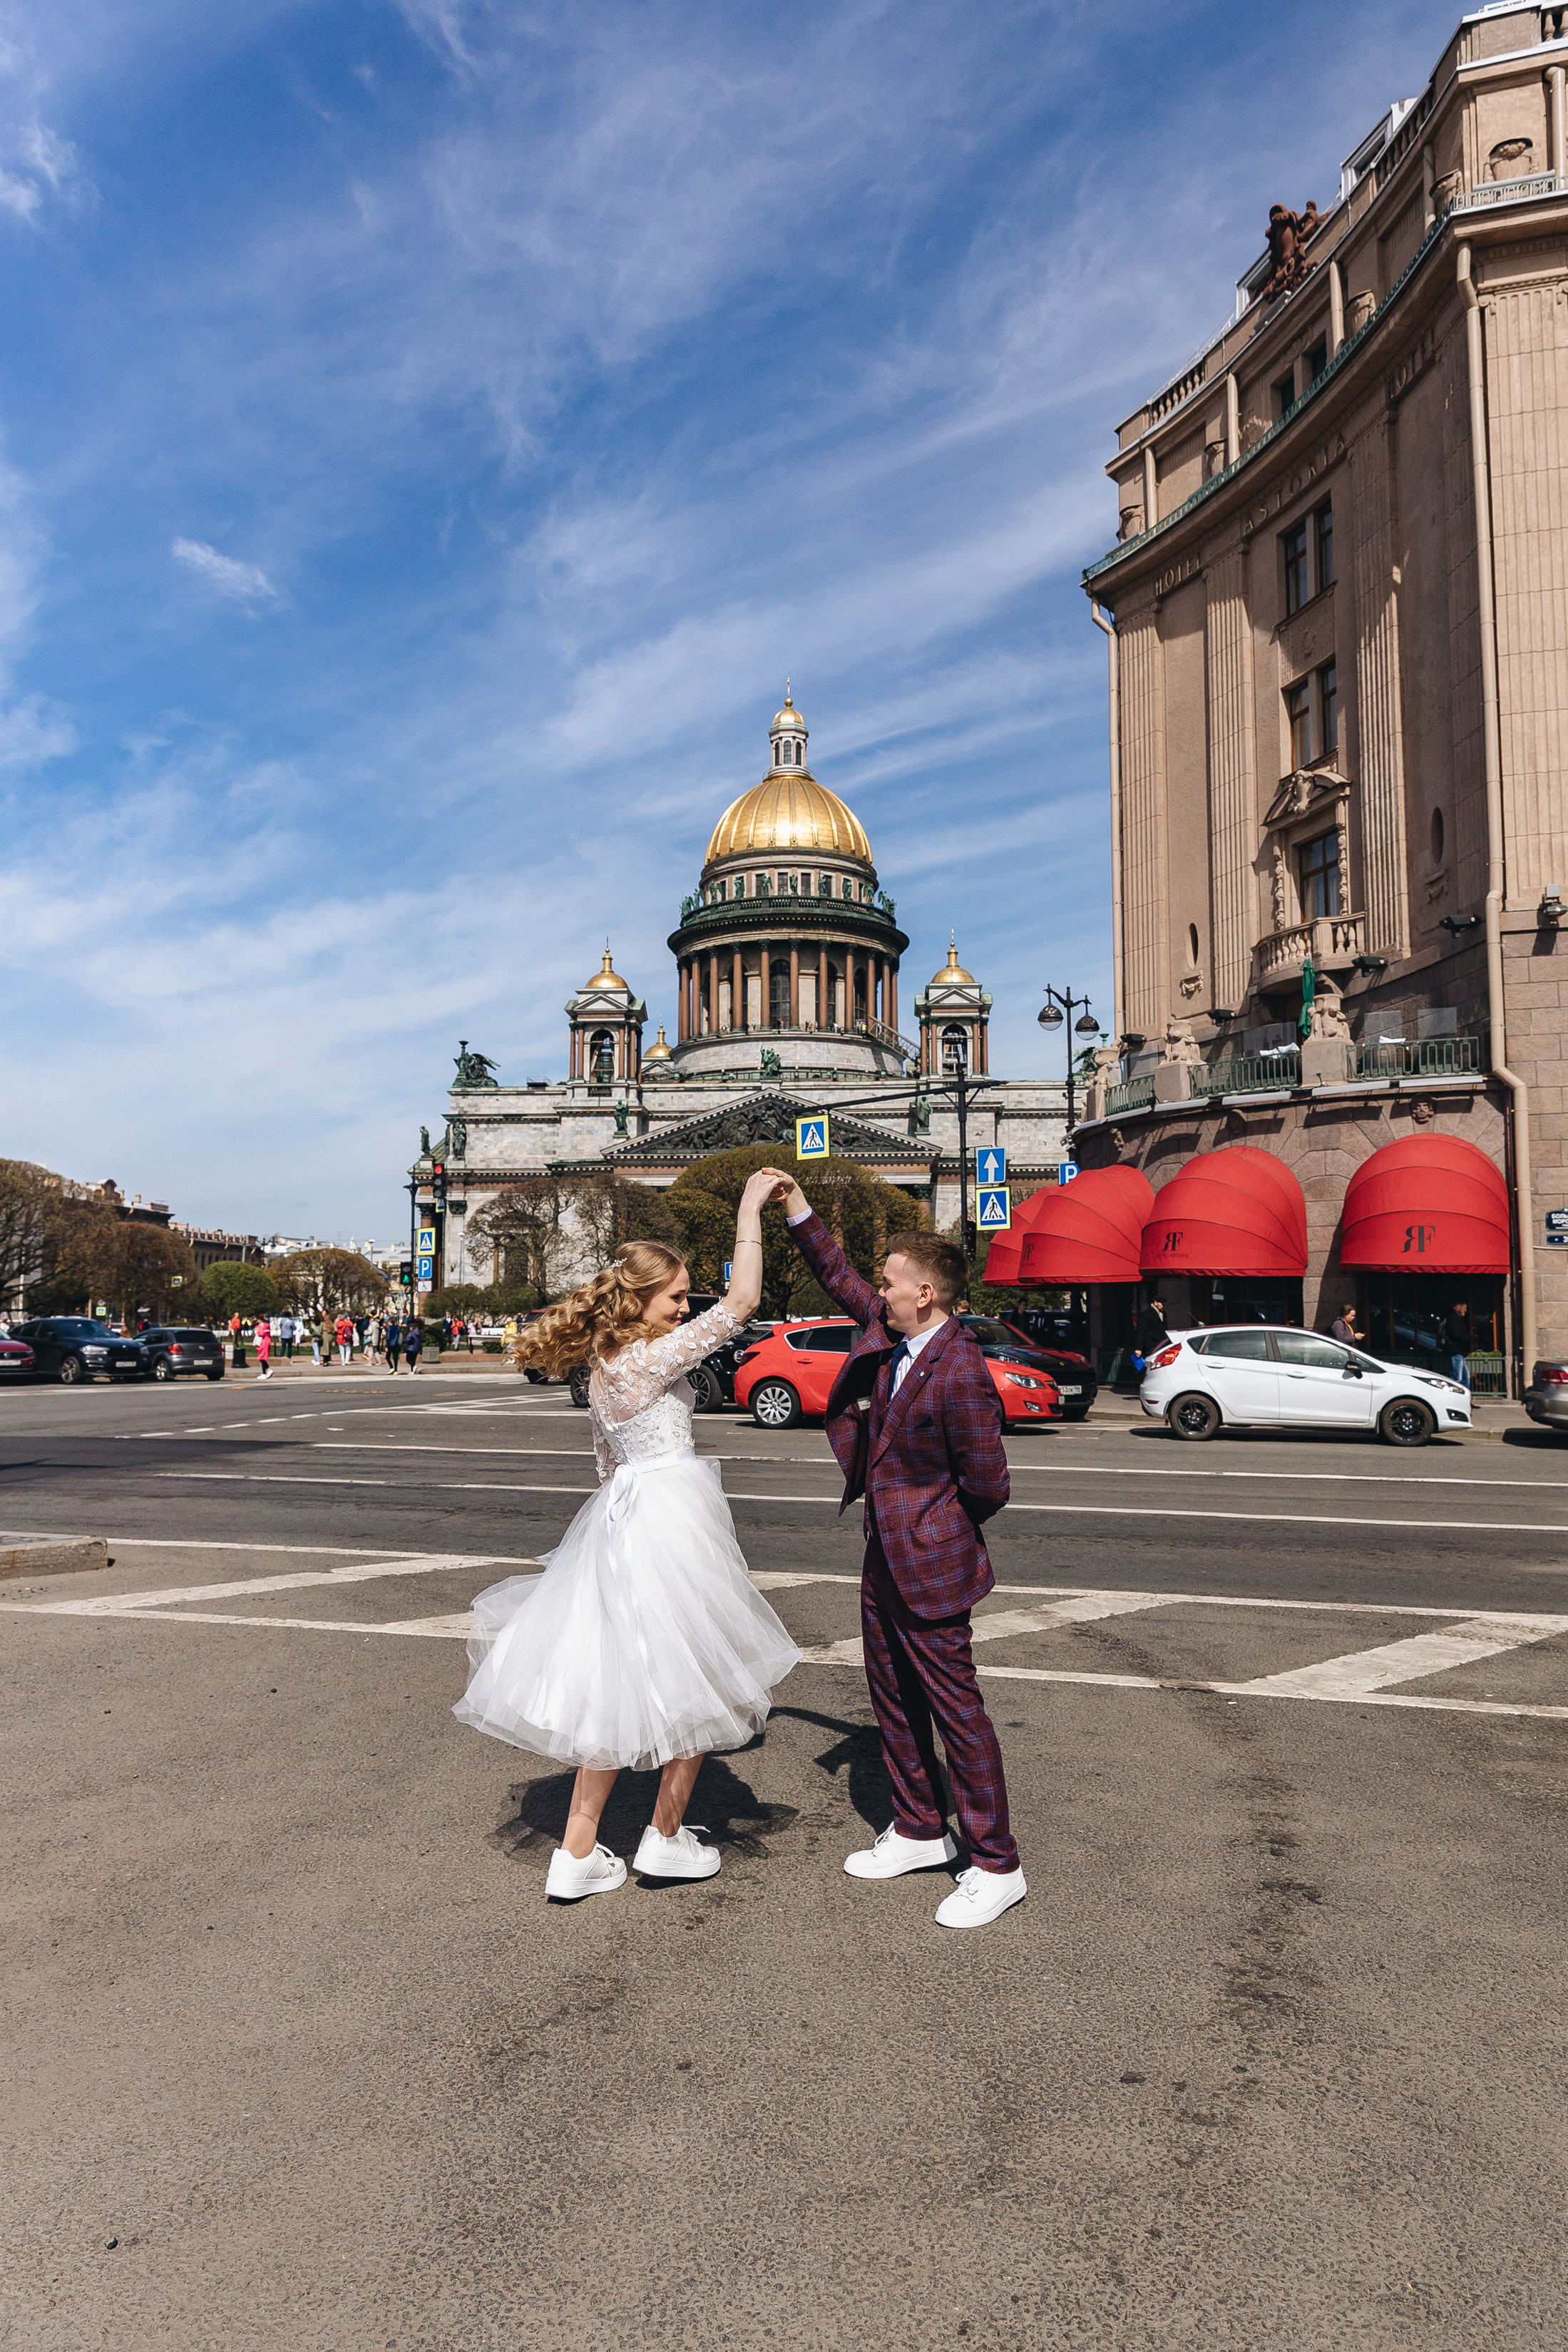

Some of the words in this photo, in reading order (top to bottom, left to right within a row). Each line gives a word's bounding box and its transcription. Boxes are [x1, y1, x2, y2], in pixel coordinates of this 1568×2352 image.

[1243, 432, 1346, 536] ASTORIA
[1155, 558, 1201, 595] HOTEL
[1065, 1165, 1077, 1184] P
[421, 1259, 429, 1276] P
